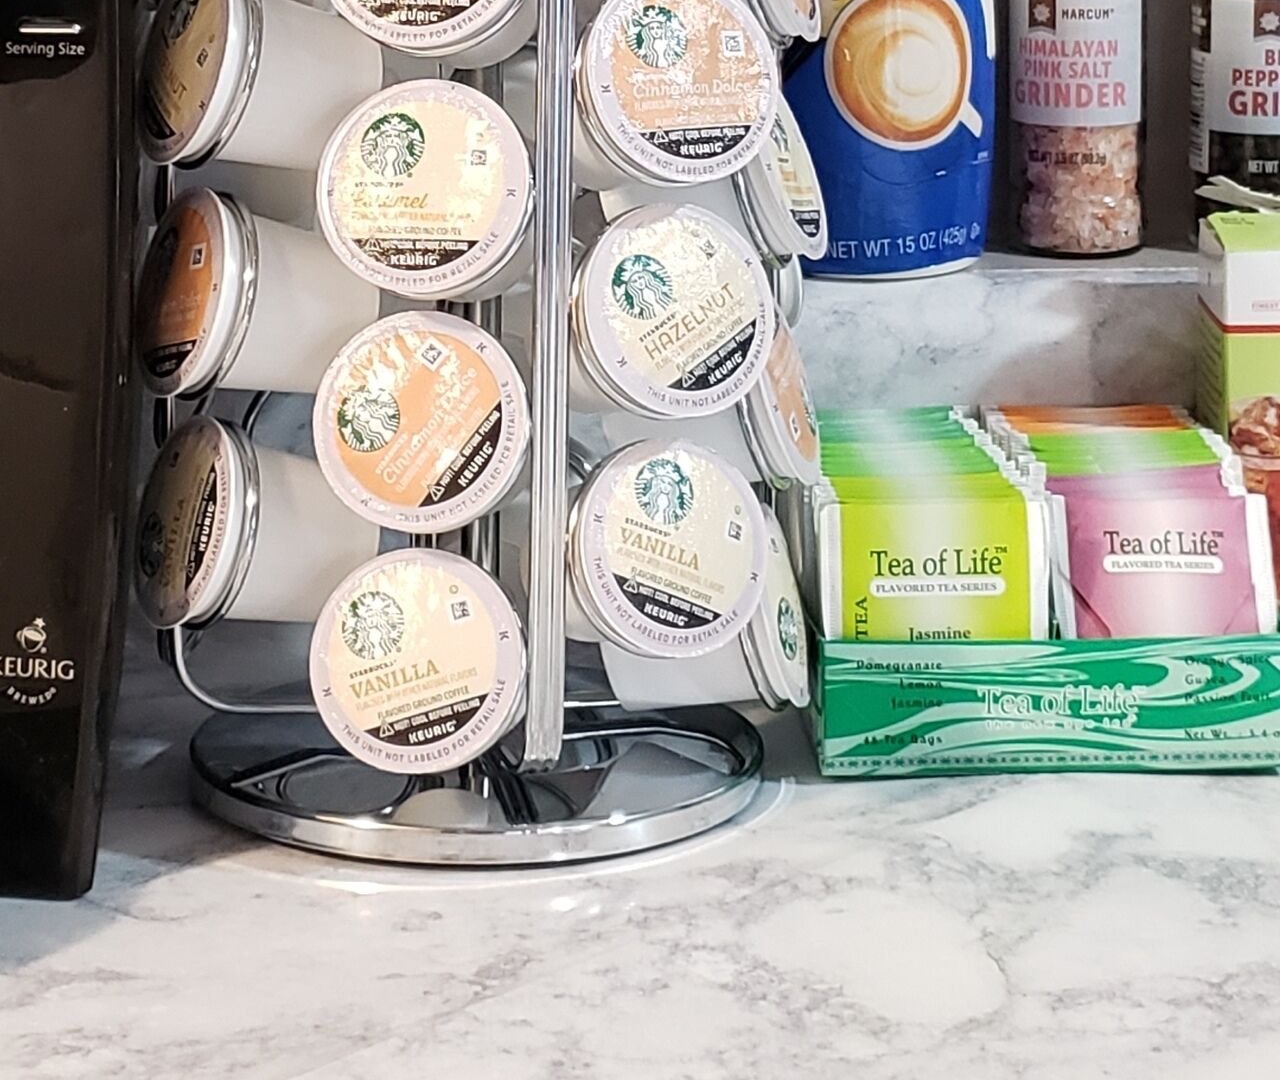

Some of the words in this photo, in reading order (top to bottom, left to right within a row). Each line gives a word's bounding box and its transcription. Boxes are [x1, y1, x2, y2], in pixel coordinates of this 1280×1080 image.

[450, 10, 482, 32] RETAIL
[6, 42, 54, 58] Serving
[58, 42, 85, 55] Size
[1019, 38, 1118, 58] HIMALAYAN
[1024, 59, 1062, 78] PINK
[1068, 61, 1112, 79] SALT
[1014, 80, 1126, 108] GRINDER
[675, 165, 714, 175] LABELED
[827, 241, 858, 258] NET
[863, 239, 891, 258] WT
[897, 236, 915, 254] 15
[920, 231, 937, 251] OZ
[390, 253, 437, 265] KEURIG
[428, 275, 448, 284] FOR
[451, 254, 481, 276] RETAIL
[480, 231, 499, 254] SALE
[644, 283, 734, 360] HAZELNUT
[707, 350, 743, 385] KEURIG
[647, 386, 666, 402] THIS
[669, 396, 689, 407] UNIT
[692, 396, 710, 407] NOT
[711, 378, 744, 403] LABELED
[457, 440, 494, 487] KEURIG
[424, 511, 446, 522] UNIT
[449, 502, 469, 516] NOT
[624, 517, 669, 538] STARBUCKS
[620, 526, 700, 570] VANILLA
[1103, 531, 1144, 554] Tea
[1150, 530, 1171, 555] of
[870, 550, 915, 576] Tea
[923, 548, 947, 576] of
[1112, 561, 1162, 569] FLAVORED
[1164, 561, 1183, 569] TEA
[1184, 561, 1215, 570] SERIES
[631, 566, 663, 586] FLAVORED
[664, 576, 690, 595] GROUND
[690, 587, 713, 604] COFFEE
[876, 583, 935, 593] FLAVORED
[937, 583, 958, 593] TEA
[961, 582, 997, 592] SERIES
[593, 557, 606, 580] THIS
[601, 583, 617, 605] UNIT
[616, 604, 632, 621] NOT
[631, 619, 669, 644] LABELED
[672, 635, 689, 645] FOR
[692, 629, 719, 643] RETAIL
[720, 610, 739, 629] SALE
[644, 602, 688, 626] KEURIG
[854, 597, 868, 640] TEA
[908, 627, 971, 641] Jasmine
[856, 660, 942, 673] Pomegranate
[349, 658, 440, 700] VANILLA
[900, 678, 943, 689] Lemon
[378, 704, 412, 720] FLAVORED
[412, 693, 443, 709] GROUND
[444, 685, 470, 701] COFFEE
[891, 698, 943, 710] Jasmine
[977, 687, 1032, 715] Tea
[1040, 684, 1073, 715] of
[1241, 691, 1270, 702] Fruit
[342, 725, 359, 744] THIS
[361, 741, 382, 757] UNIT
[385, 752, 404, 763] NOT
[408, 747, 451, 764] LABELED
[452, 735, 470, 751] FOR
[471, 707, 496, 735] RETAIL
[492, 679, 506, 704] SALE
[408, 720, 457, 744] KEURIG
